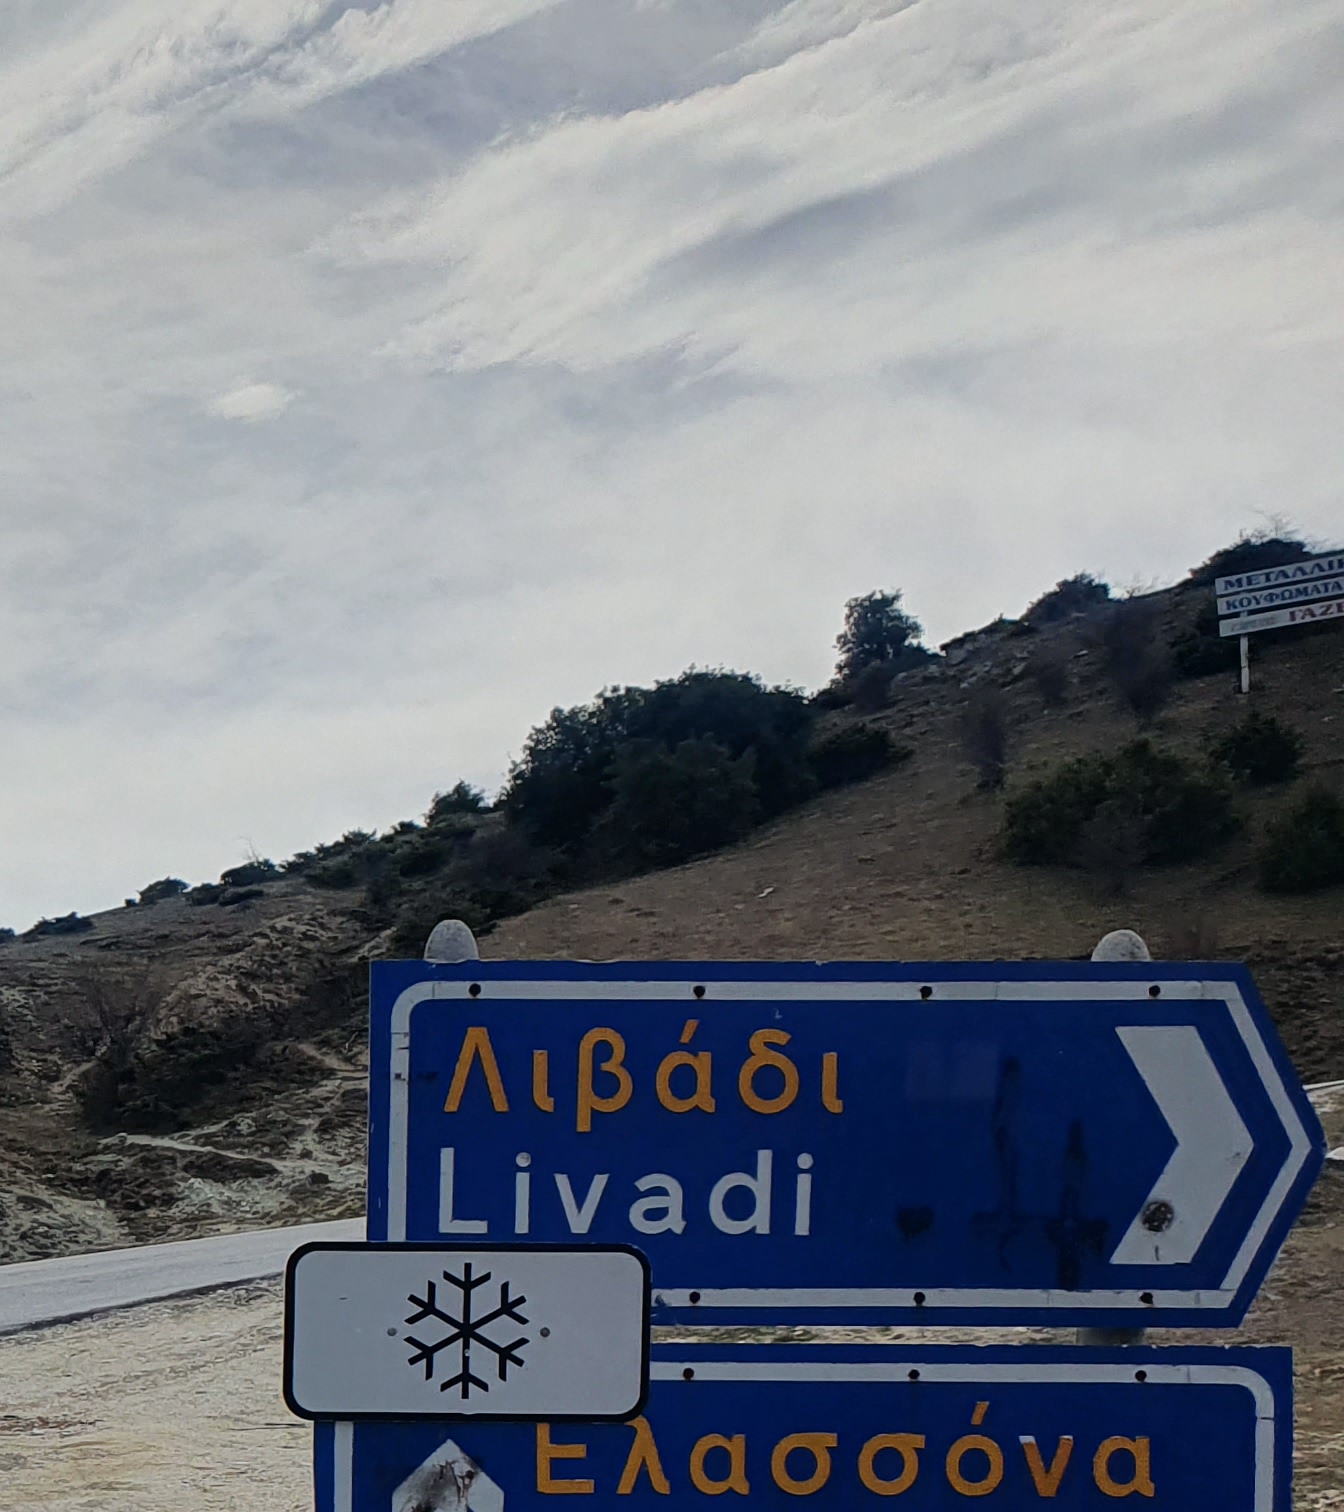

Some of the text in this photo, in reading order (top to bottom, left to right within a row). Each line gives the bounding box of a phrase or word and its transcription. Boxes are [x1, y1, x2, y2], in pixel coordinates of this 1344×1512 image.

[1225, 581, 1343, 611] ΚΟΥΦΩΜΑΤΑ
[444, 1019, 843, 1132] Λιβάδι
[438, 1147, 813, 1235] Livadi
[536, 1402, 1155, 1497] Ελασσόνα
